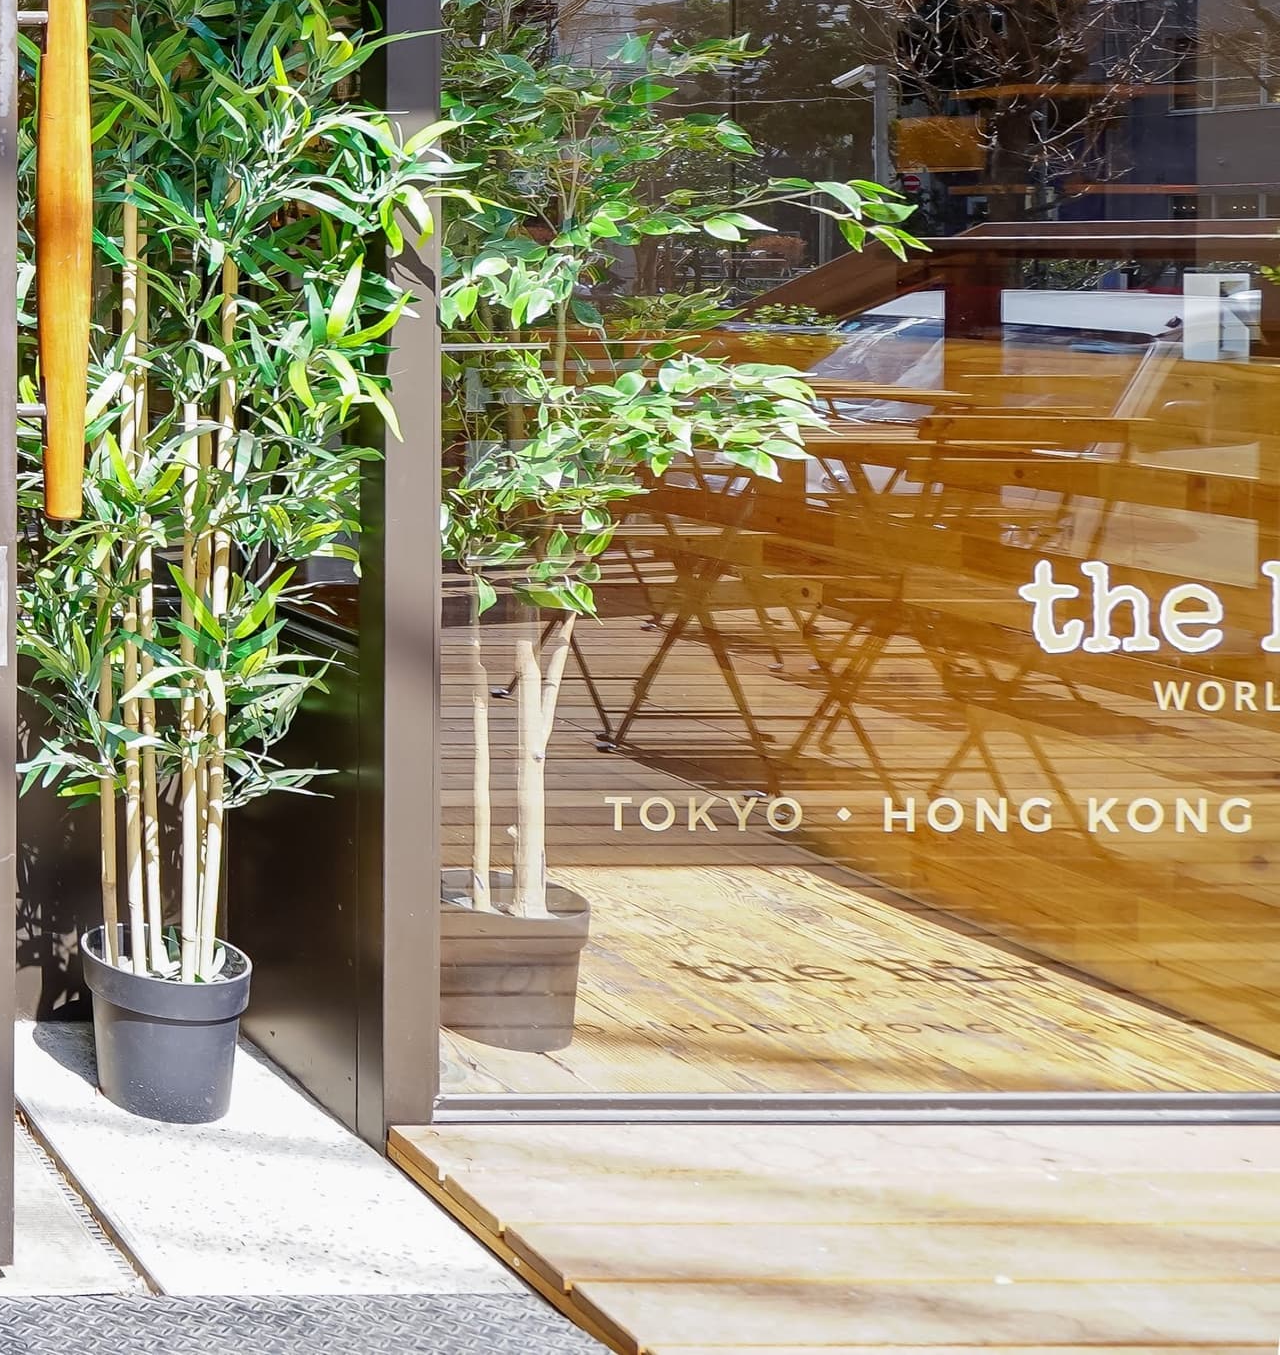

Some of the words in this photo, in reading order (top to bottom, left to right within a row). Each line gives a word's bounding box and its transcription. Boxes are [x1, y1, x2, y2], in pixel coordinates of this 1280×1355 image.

[1016, 558, 1225, 654] the
[604, 795, 805, 833] TOKYO
[882, 795, 1054, 834] HONG
[1086, 795, 1255, 834] KONG
